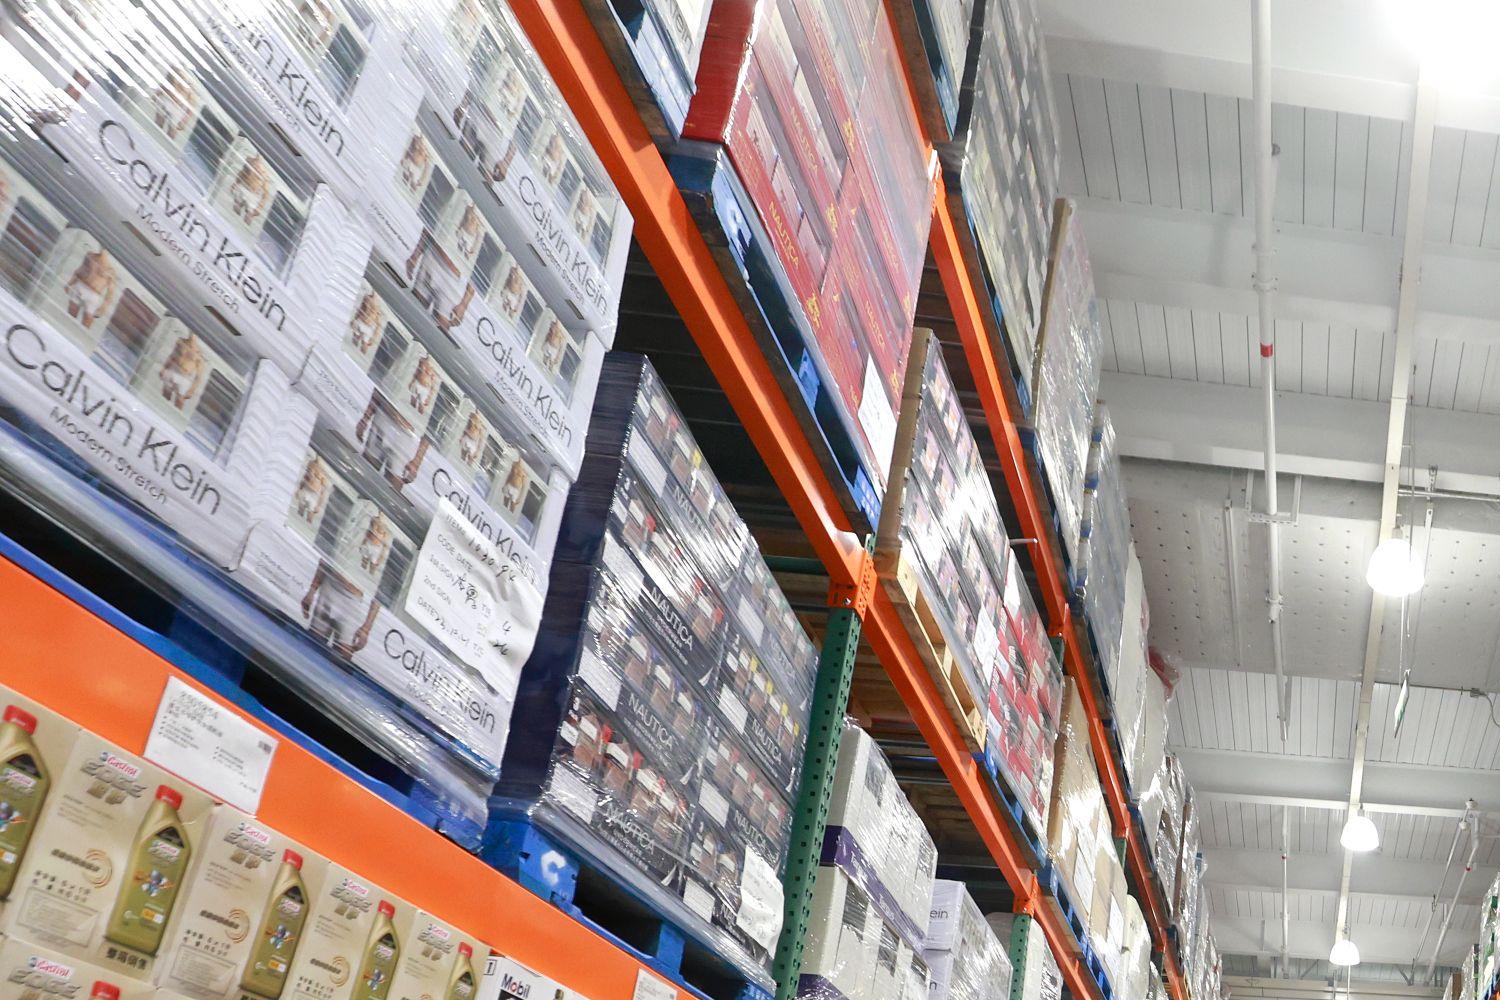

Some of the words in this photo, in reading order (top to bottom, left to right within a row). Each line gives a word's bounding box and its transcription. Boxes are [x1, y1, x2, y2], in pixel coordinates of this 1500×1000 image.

[277, 58, 345, 157] Klein
[100, 119, 210, 252] Calvin
[214, 237, 287, 332] Klein
[135, 203, 191, 267] Modern
[194, 262, 240, 314] Stretch
[518, 176, 572, 262] Calvin
[574, 251, 608, 315] Klein
[769, 201, 800, 270] NAUTICA
[6, 324, 133, 447] Calvin
[138, 427, 221, 515] Klein
[476, 316, 533, 400] Calvin
[535, 391, 572, 447] Klein
[50, 406, 113, 463] Modern
[114, 457, 168, 505] Stretch
[432, 468, 493, 546] Calvin
[651, 587, 694, 651] NAUTICA
[629, 693, 675, 750] NAUTICA
[752, 718, 783, 766] NAUTICA
[929, 908, 950, 920] ein
[501, 973, 530, 998] Mobil
